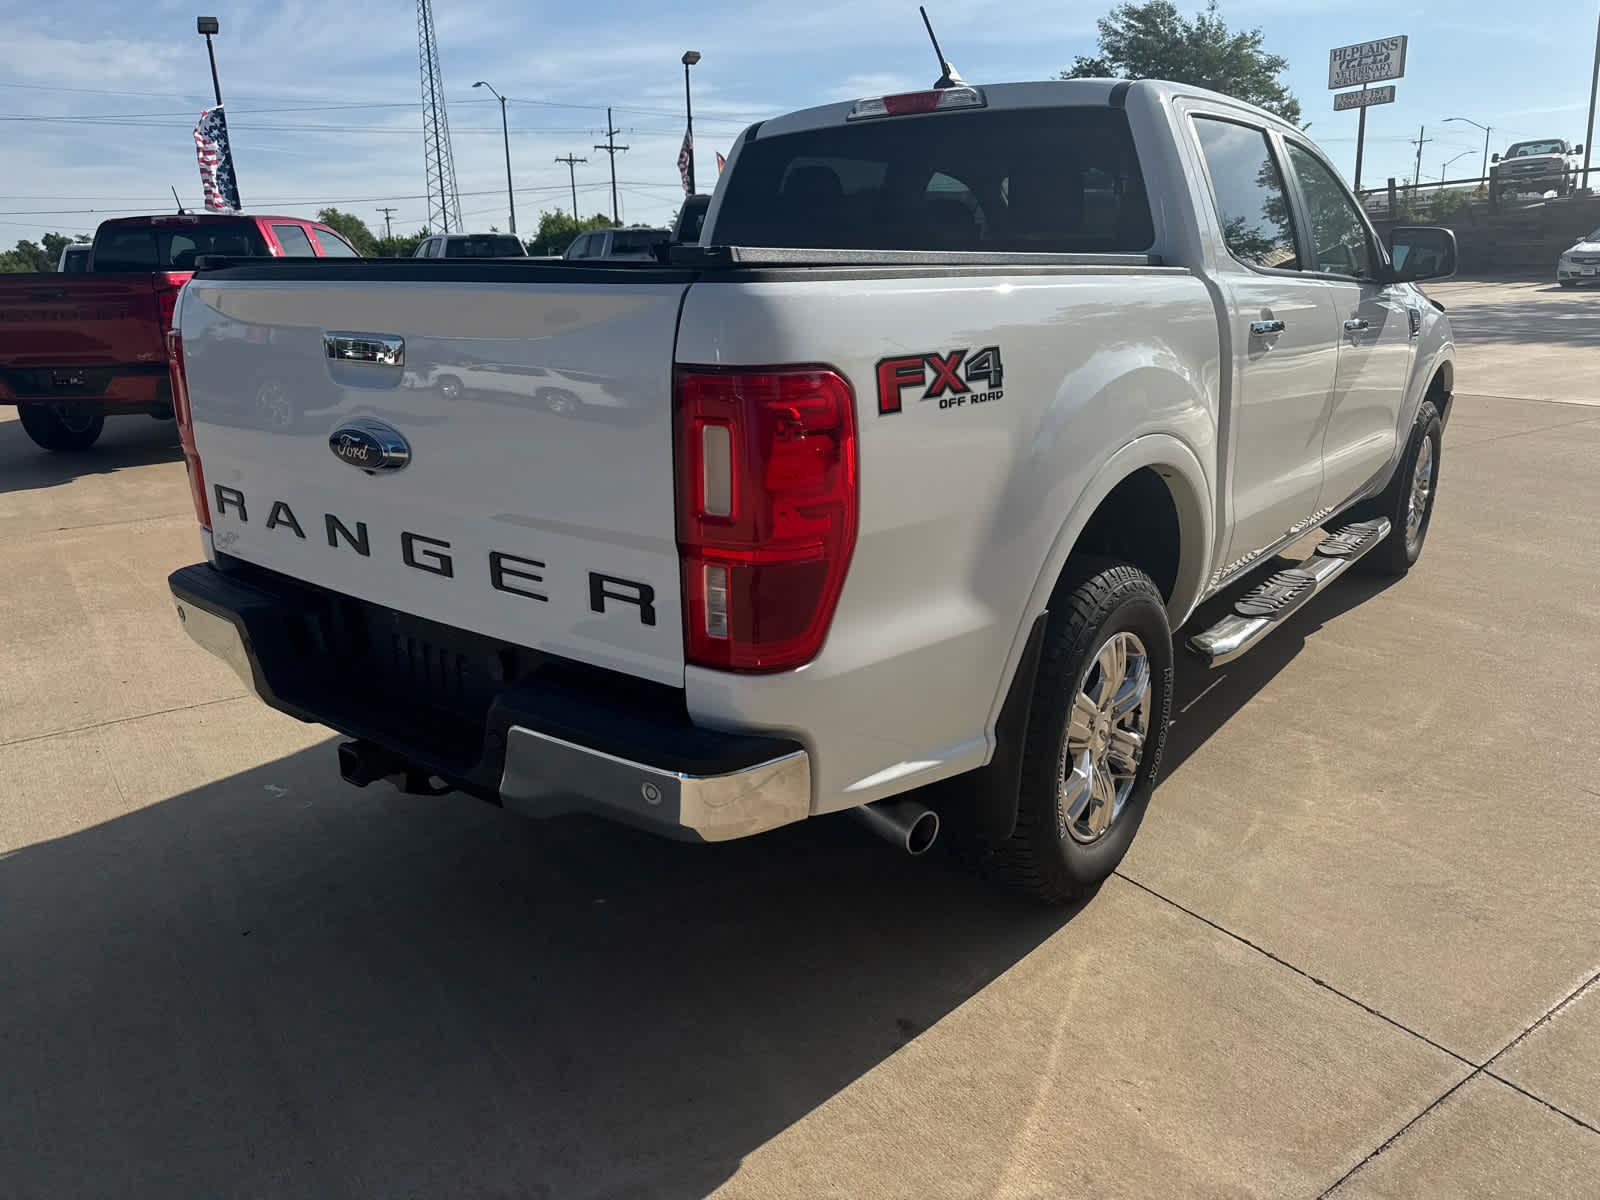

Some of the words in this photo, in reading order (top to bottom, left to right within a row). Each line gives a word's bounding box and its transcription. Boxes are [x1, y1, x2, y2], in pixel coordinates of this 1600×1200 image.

[875, 346, 1003, 416] FX4
[939, 396, 967, 409] OFF
[970, 390, 1004, 404] ROAD
[337, 433, 369, 461] Ford
[214, 483, 656, 626] RANGER
